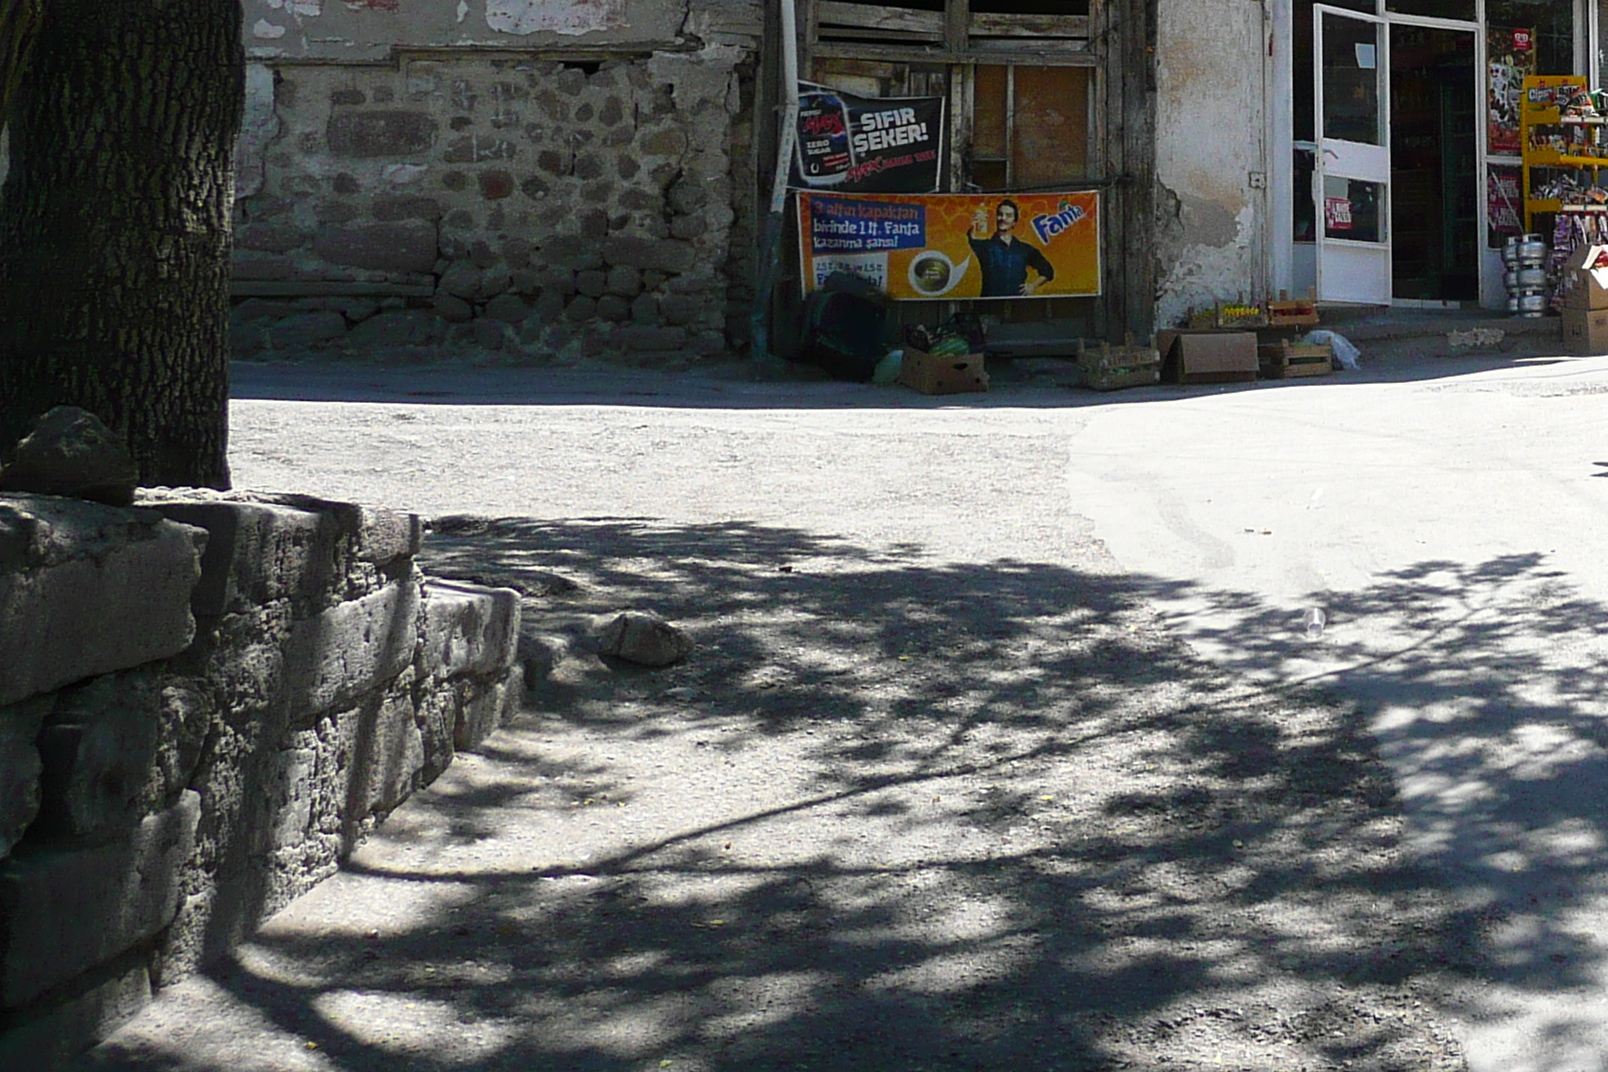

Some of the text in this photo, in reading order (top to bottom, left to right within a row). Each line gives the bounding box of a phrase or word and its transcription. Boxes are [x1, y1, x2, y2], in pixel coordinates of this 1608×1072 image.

[860, 107, 916, 132] SIFIR
[854, 122, 929, 158] ŞEKER!
[814, 201, 823, 215] 3
[884, 221, 920, 236] Fanta
[1030, 204, 1086, 245] Fanta
